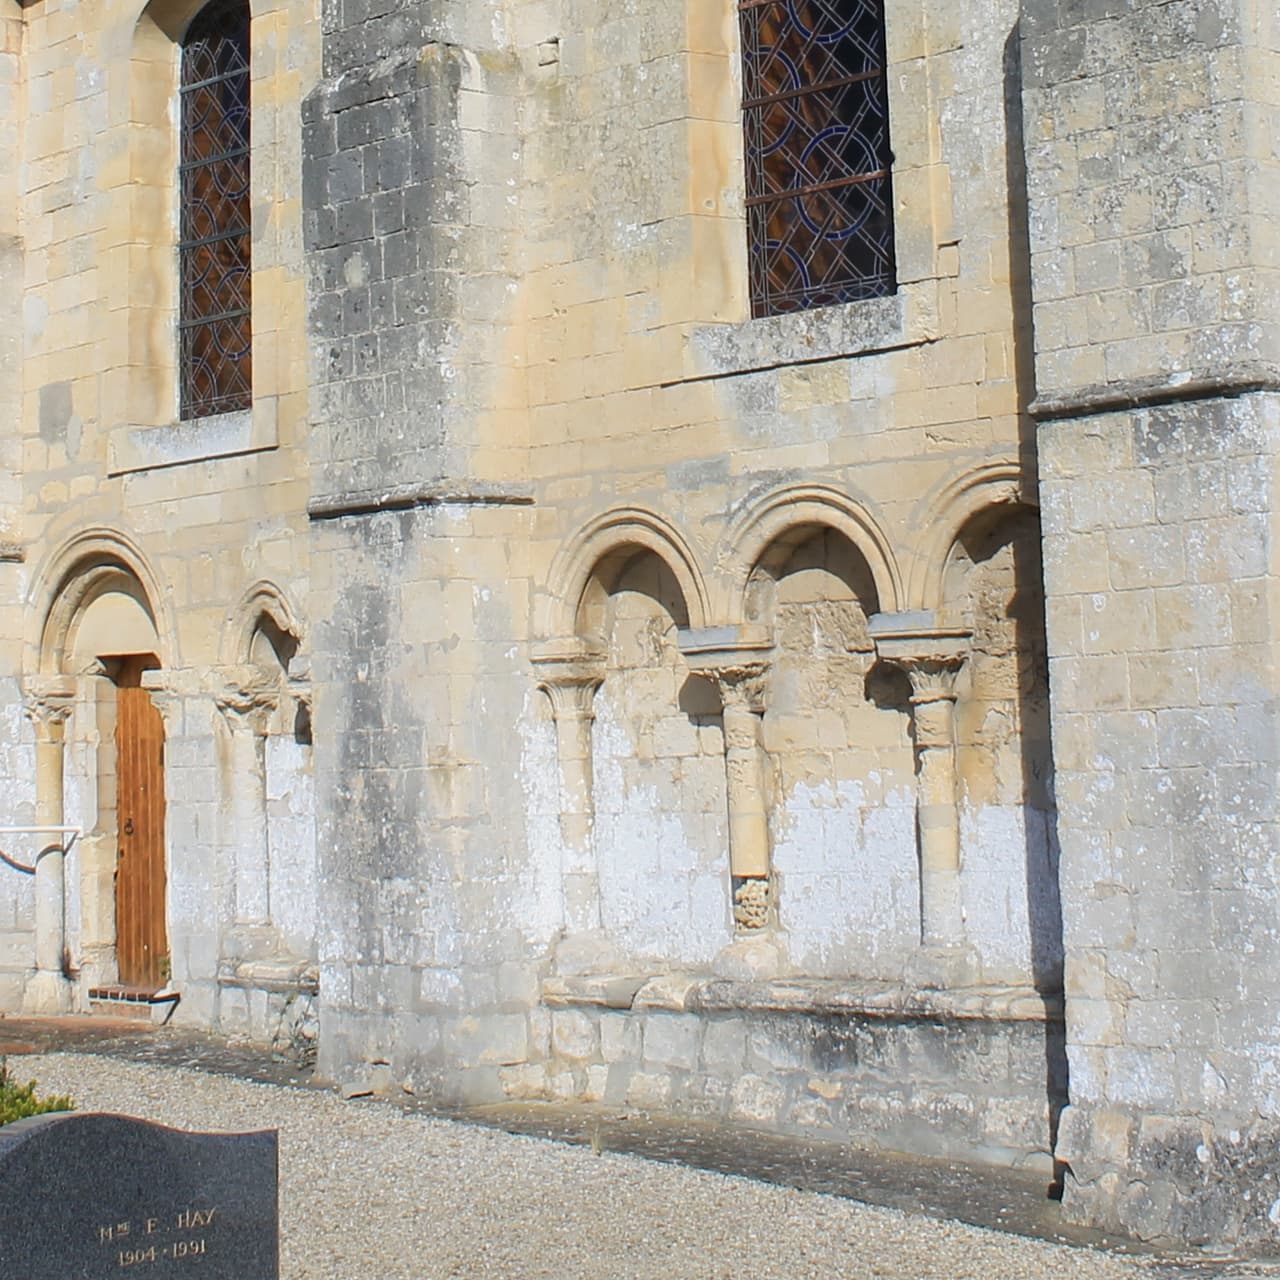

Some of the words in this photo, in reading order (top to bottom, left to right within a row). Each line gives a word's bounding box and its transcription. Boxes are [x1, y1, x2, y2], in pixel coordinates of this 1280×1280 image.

[177, 1207, 217, 1229] HAY
[119, 1246, 156, 1267] 1904
[173, 1239, 206, 1258] 1991
